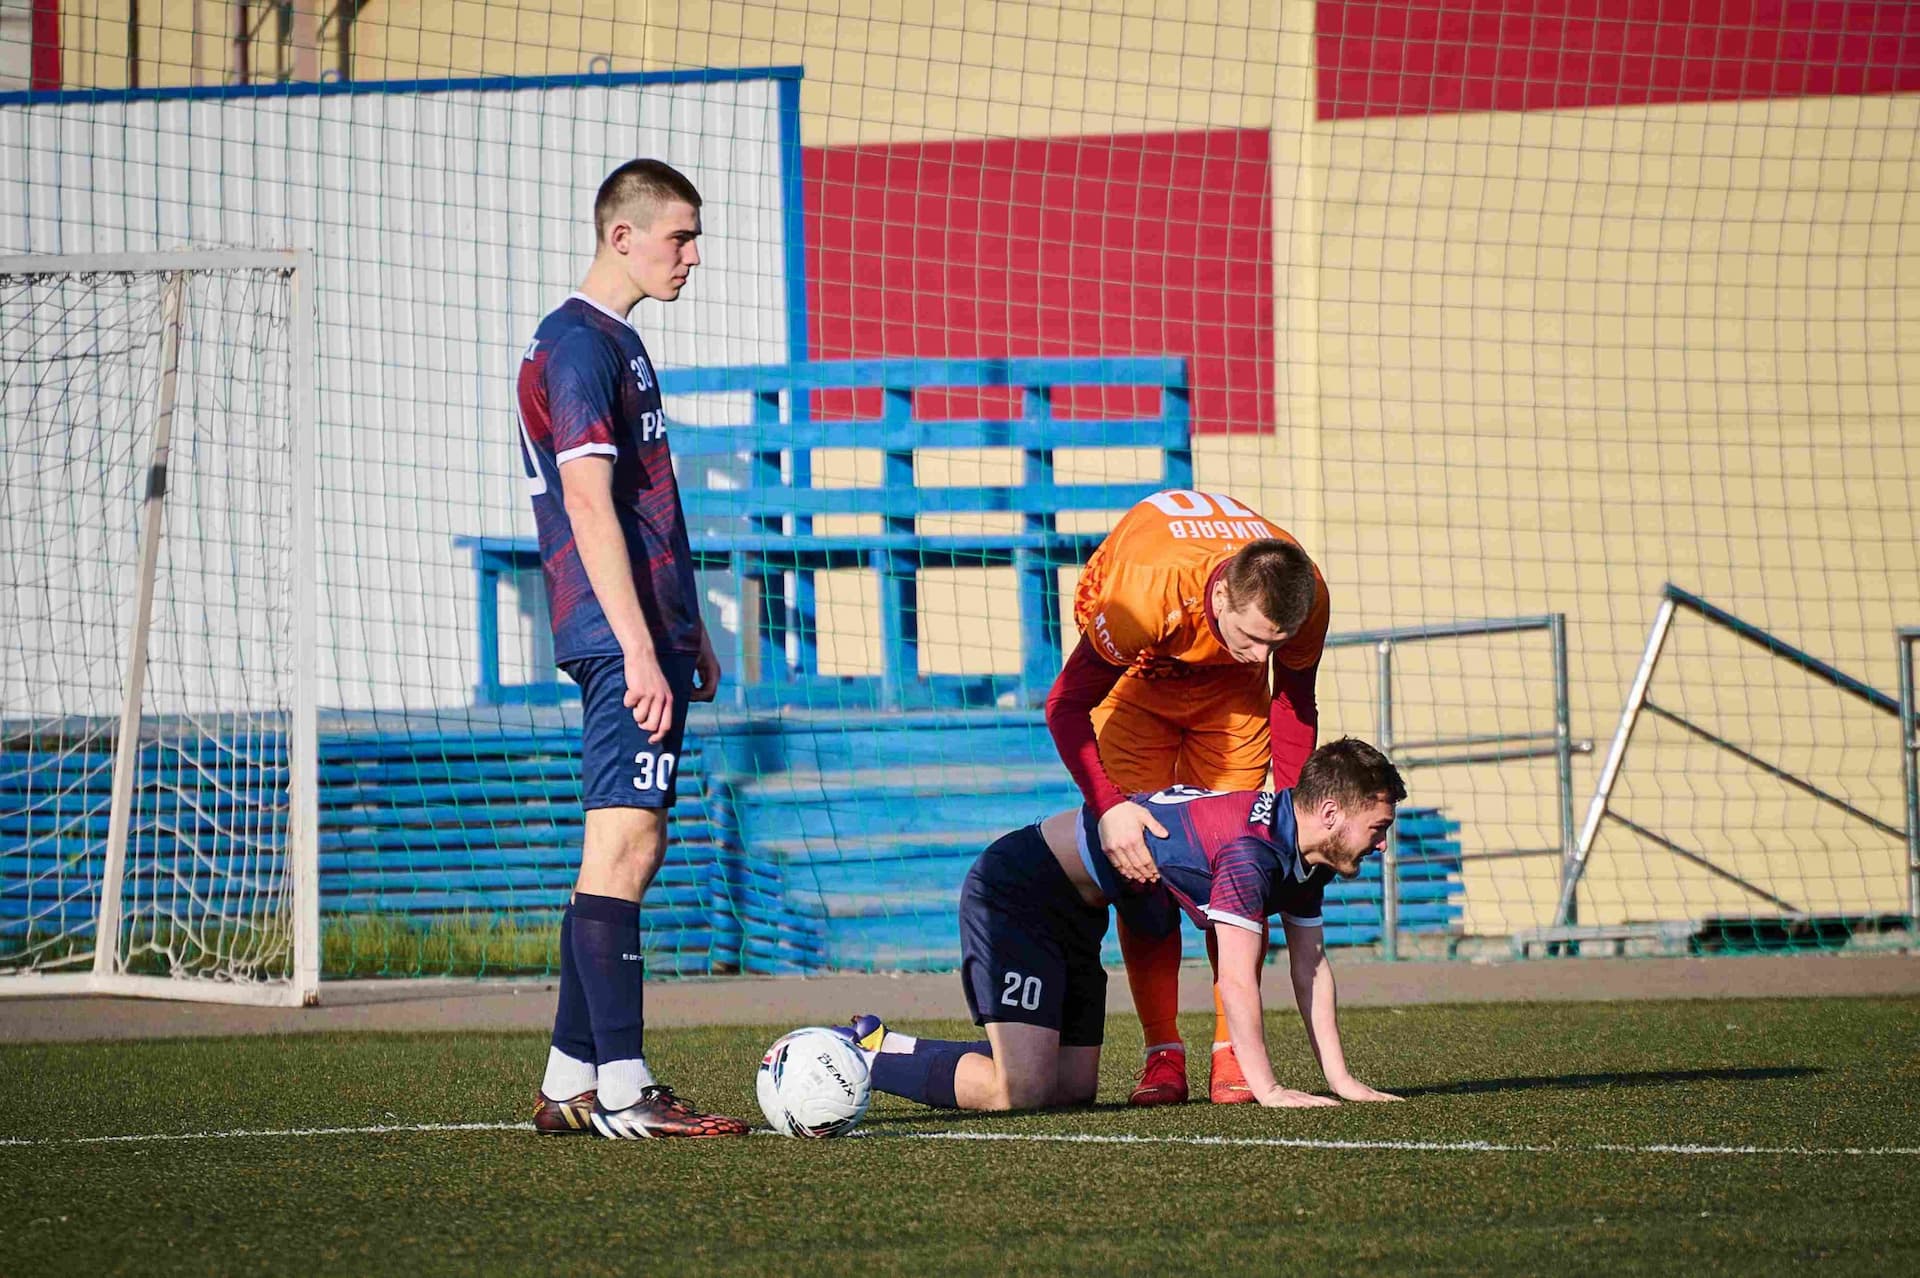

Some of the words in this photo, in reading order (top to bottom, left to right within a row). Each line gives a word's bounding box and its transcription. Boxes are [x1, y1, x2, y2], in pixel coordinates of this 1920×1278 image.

[630, 355, 653, 391] 30
[1168, 520, 1273, 539] ШИБАЕВ
[633, 751, 675, 791] 30
[1001, 971, 1042, 1011] 20
